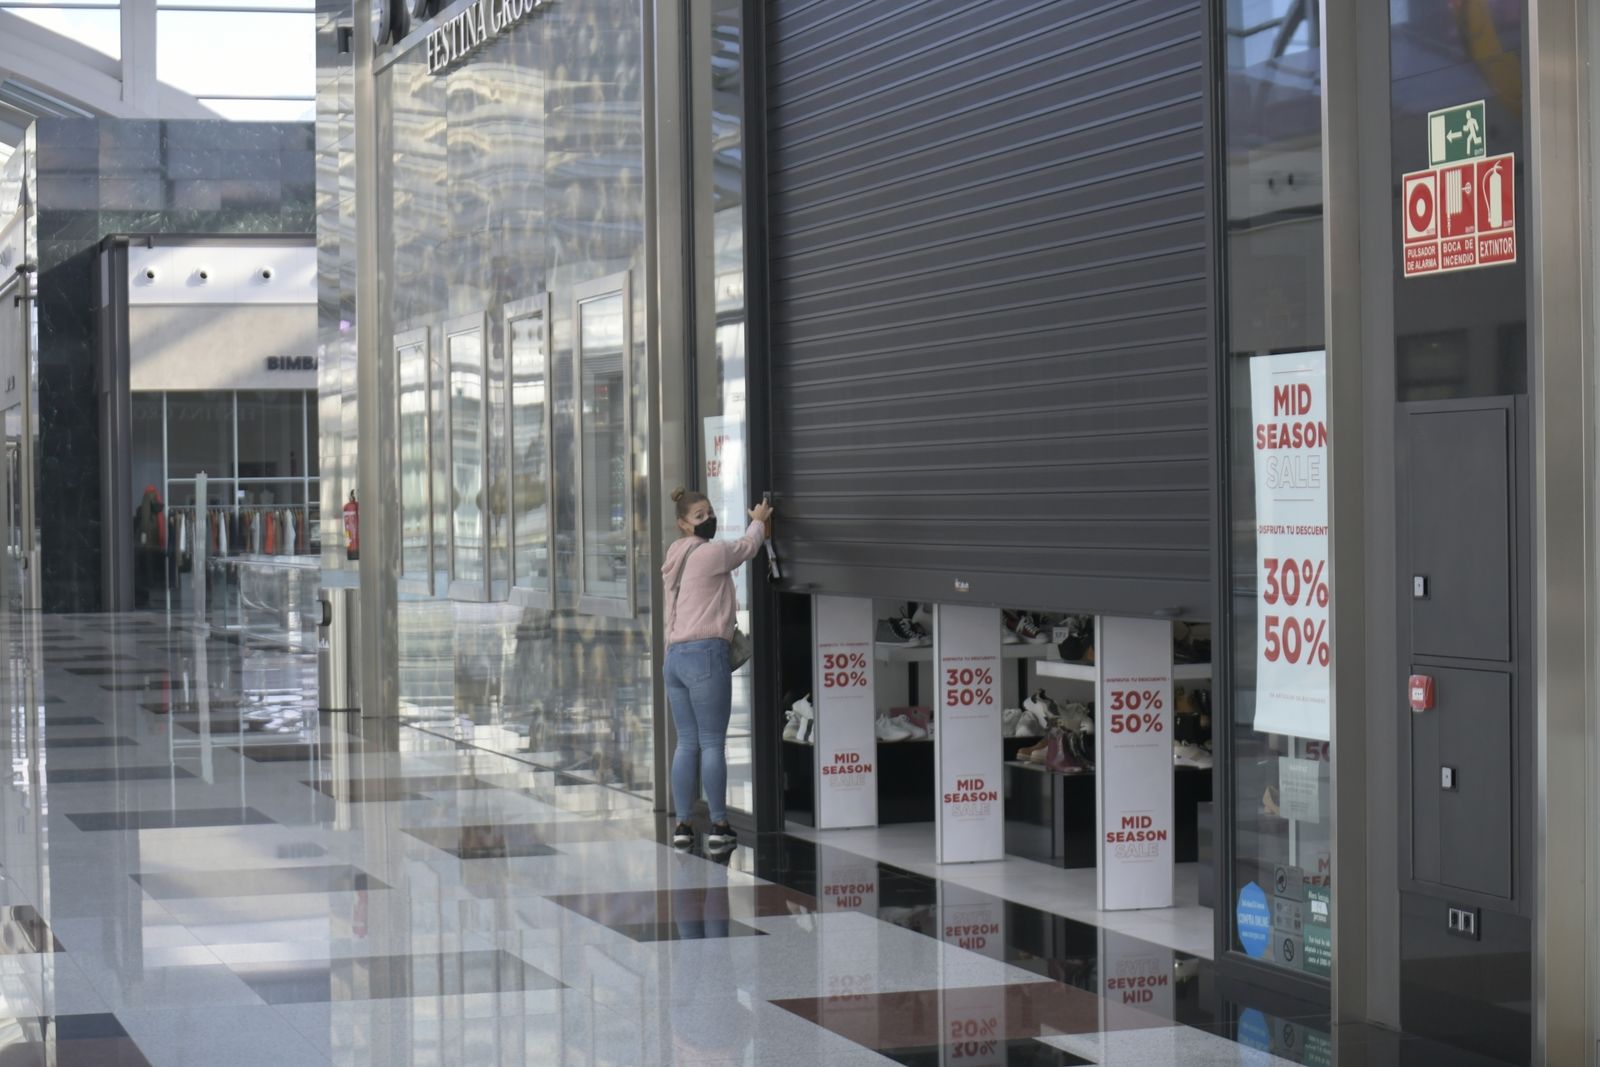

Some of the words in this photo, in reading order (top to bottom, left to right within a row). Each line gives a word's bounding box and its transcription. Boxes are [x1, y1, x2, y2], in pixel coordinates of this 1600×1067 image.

[426, 0, 487, 75] FESTINA
[1407, 245, 1436, 258] PULSADOR
[1443, 241, 1461, 253] BOCA
[1465, 239, 1474, 250] DE
[1480, 237, 1513, 257] EXTINTOR
[1407, 261, 1414, 271] DE
[1415, 259, 1437, 269] ALARMA
[1443, 253, 1474, 266] INCENDIO
[1273, 383, 1312, 416] MID
[1256, 421, 1327, 450] SEASON
[1265, 455, 1321, 489] SALE
[1287, 525, 1295, 535] TU
[1263, 557, 1329, 608] 30%
[1264, 615, 1330, 667] 50%
[824, 653, 866, 669] 30%
[824, 671, 867, 688] 50%
[946, 667, 993, 686] 30%
[946, 688, 993, 707] 50%
[1110, 690, 1163, 710] 30%
[1110, 713, 1163, 734] 50%
[834, 752, 860, 764] MID
[822, 764, 872, 775] SEASON
[957, 778, 985, 791] MID
[944, 791, 998, 803] SEASON
[1121, 815, 1152, 829] MID
[1106, 830, 1167, 843] SEASON
[1114, 843, 1159, 859] SALE
